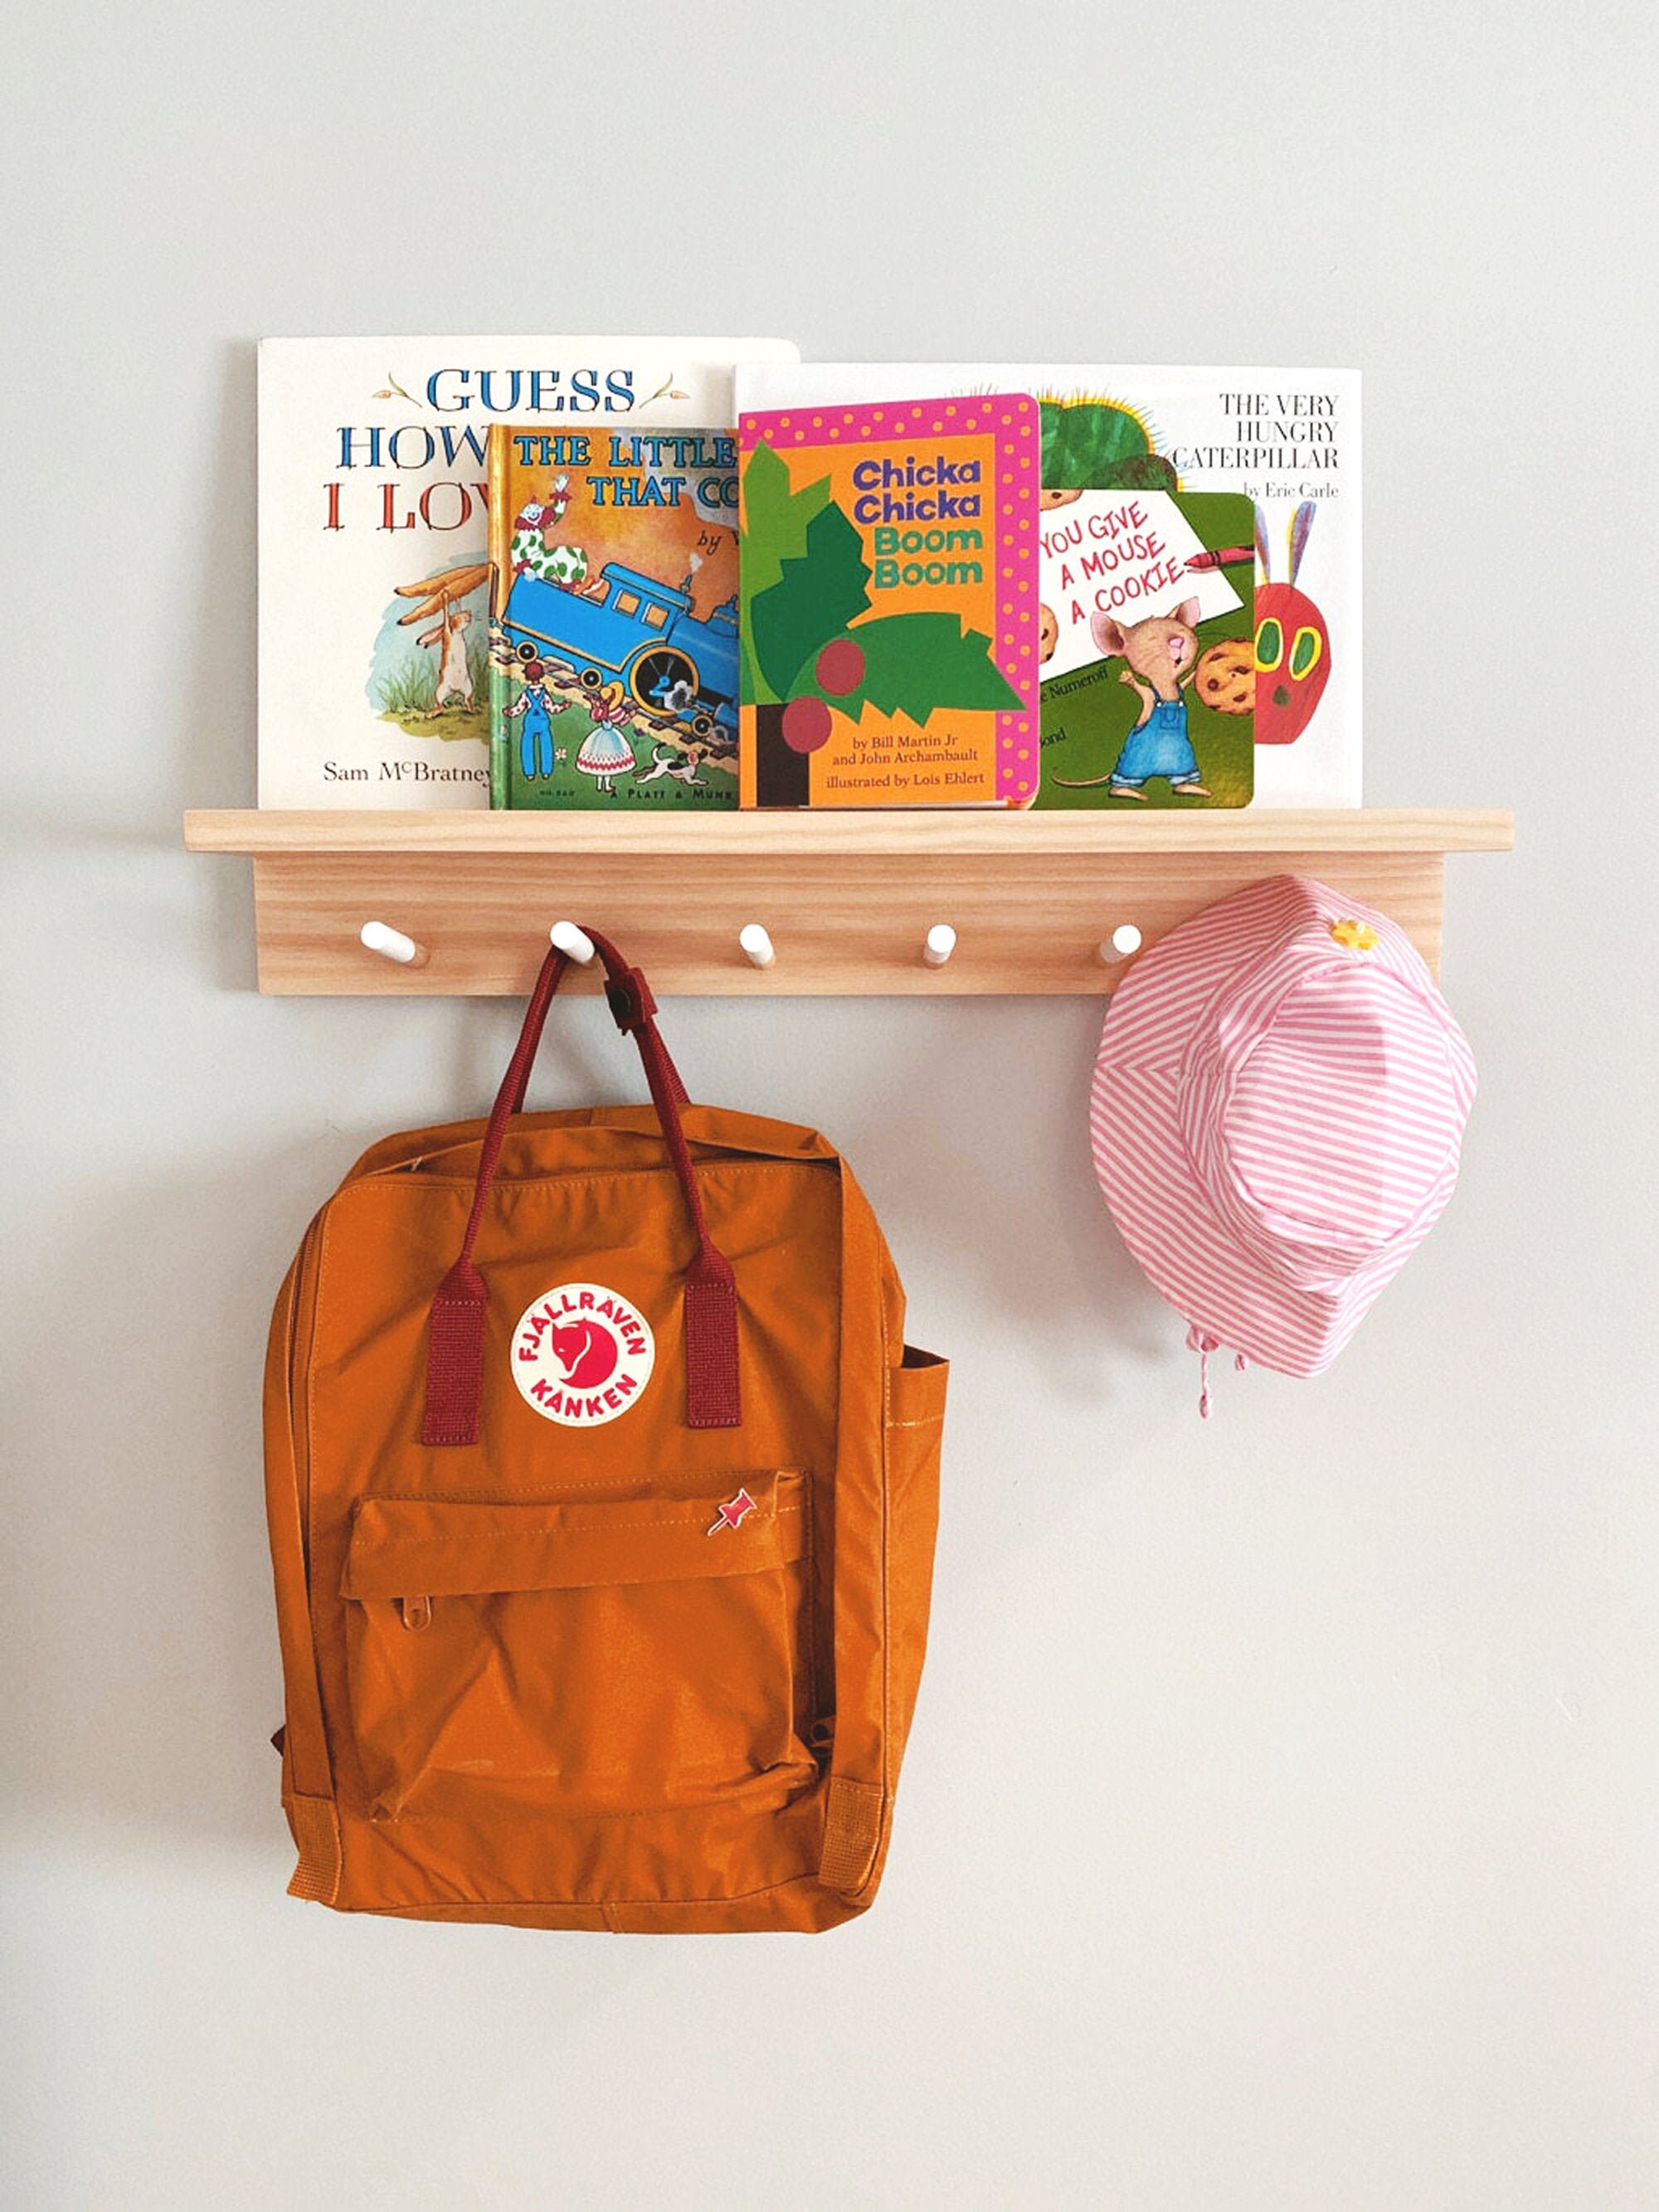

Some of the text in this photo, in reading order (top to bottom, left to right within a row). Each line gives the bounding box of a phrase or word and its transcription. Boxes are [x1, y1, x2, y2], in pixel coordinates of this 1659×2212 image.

[426, 369, 635, 413] GUESS
[1219, 393, 1340, 416] THE VERY
[336, 425, 489, 469] HOW
[1237, 421, 1340, 443] HUNGRY
[513, 435, 737, 467] THE LITTLE
[1172, 446, 1340, 469] CATERPILLAR
[852, 455, 981, 491] Chicka
[586, 476, 686, 507] THAT
[1245, 482, 1340, 498] by Eric Carle
[323, 482, 345, 532] I
[853, 489, 981, 525] Chicka
[697, 530, 722, 556] by
[874, 526, 983, 557] Boom
[1040, 501, 1148, 559] YOU GIVE
[874, 558, 983, 589] Boom
[1062, 531, 1166, 591] A MOUSE
[1072, 557, 1185, 625] A COOKIE
[1048, 665, 1108, 698] Numeroff
[832, 748, 977, 766] and John Archambault
[853, 733, 958, 751] by Bill Martin Jr
[323, 761, 369, 781] Sam
[826, 772, 985, 788] illustrated by Lois Ehlert
